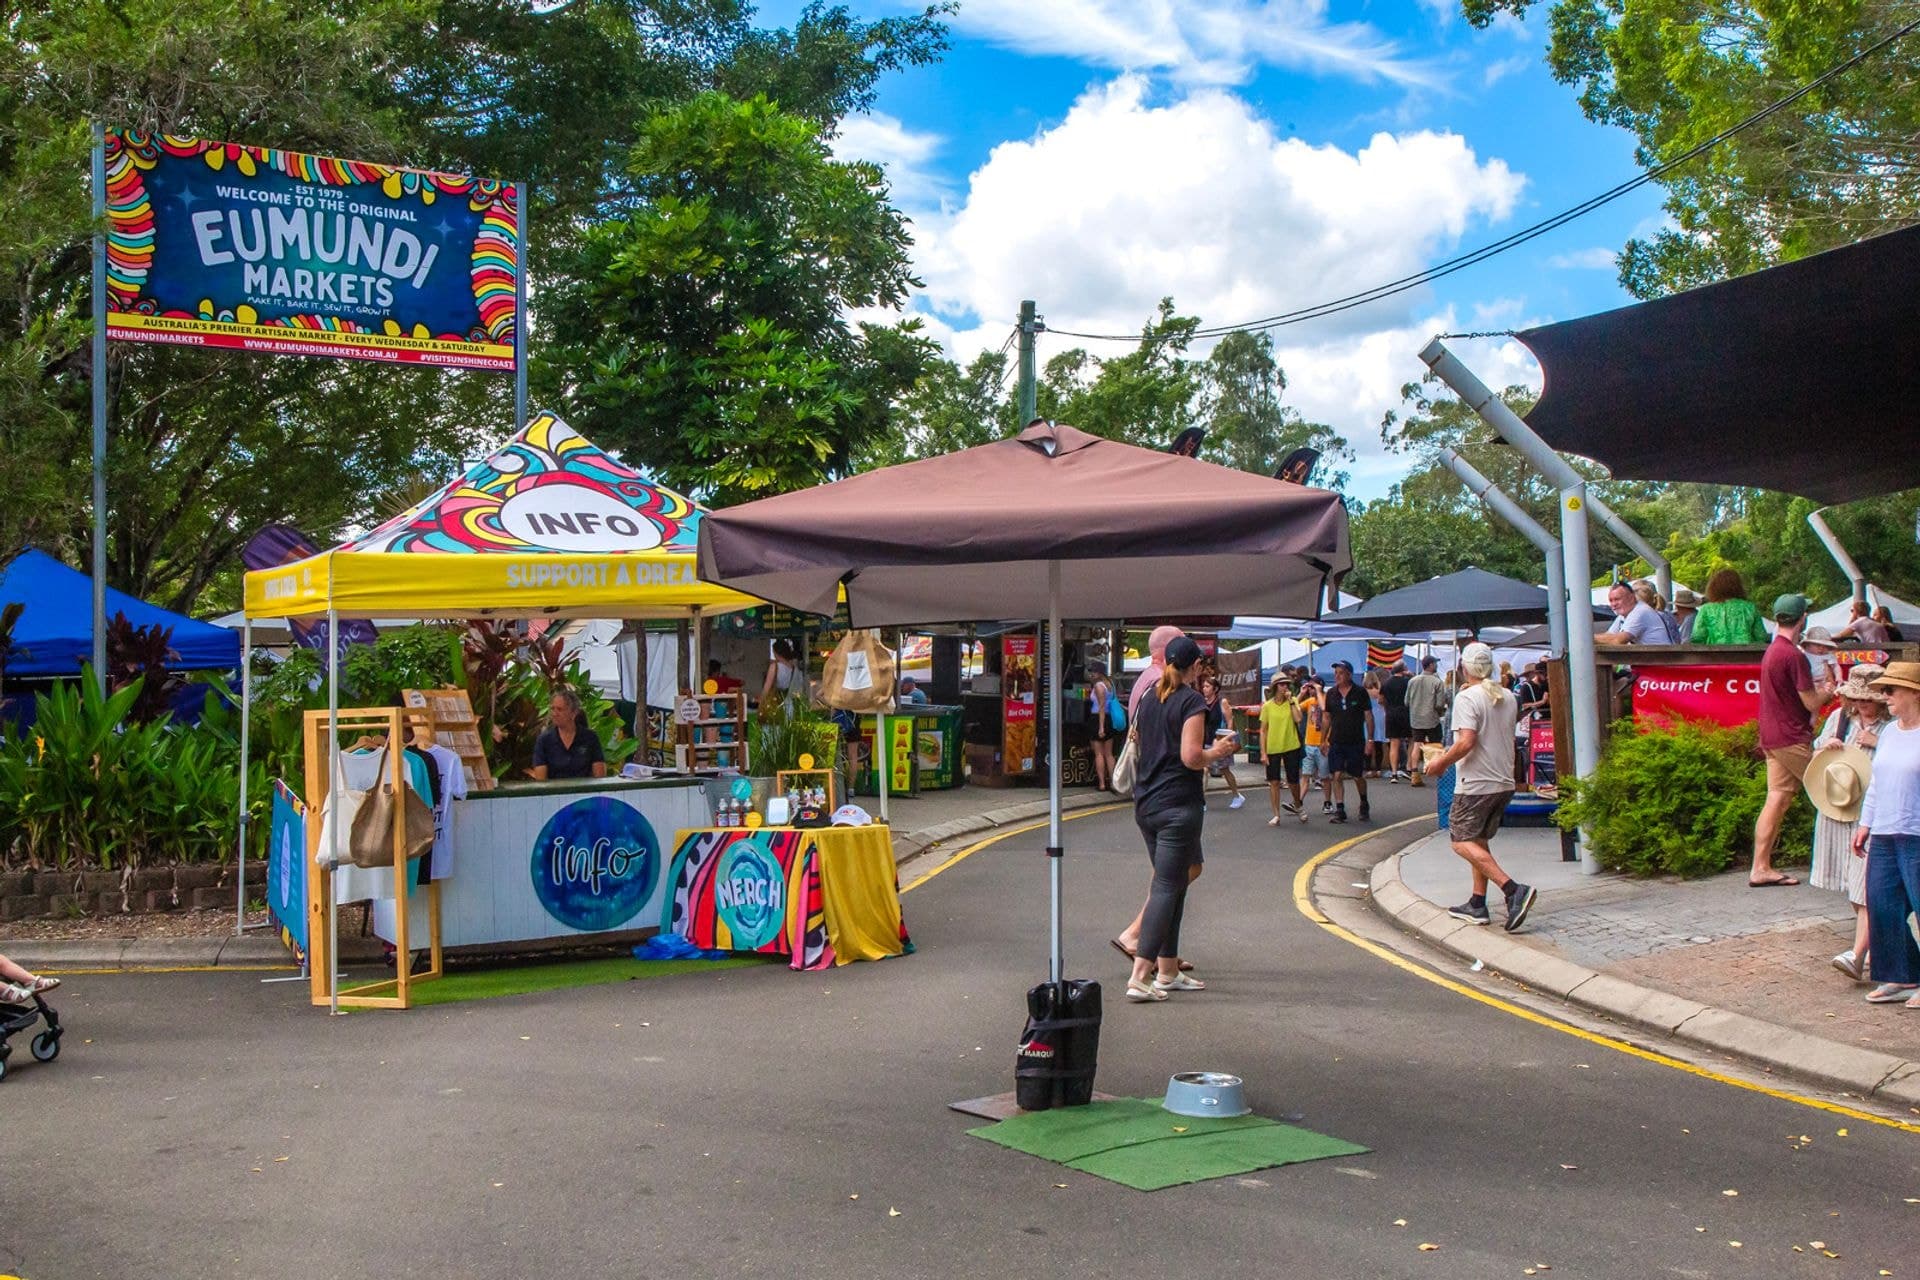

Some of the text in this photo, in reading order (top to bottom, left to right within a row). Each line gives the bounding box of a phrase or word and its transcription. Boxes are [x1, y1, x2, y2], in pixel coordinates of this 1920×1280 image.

[216, 185, 418, 222] WELCOME TO THE ORIGINAL
[295, 185, 315, 197] EST
[317, 188, 343, 200] 1979
[191, 207, 439, 289] EUMUNDI
[243, 262, 394, 308] MARKETS
[247, 296, 271, 306] MAKE
[287, 300, 309, 310] BAKE
[324, 303, 343, 312] SEW
[356, 306, 381, 316] GROW
[383, 308, 391, 317] IT
[106, 329, 205, 344] #EUMUNDIMARKETS
[143, 318, 208, 331] AUSTRALIA'S
[210, 322, 252, 335] PREMIER
[255, 326, 297, 338] ARTISAN
[298, 329, 337, 342] MARKET
[344, 335, 373, 345] EVERY
[375, 338, 430, 350] WEDNESDAY
[432, 342, 439, 350] &
[440, 343, 486, 354] SATURDAY
[243, 340, 399, 359] WWW.EUMUNDIMARKETS.COM.AU
[420, 353, 514, 369] #VISITSUNSHINECOAST
[524, 512, 640, 537] INFO
[506, 561, 698, 588] SUPPORT A DREA
[1636, 677, 1713, 698] gourmet
[552, 836, 647, 896] info
[717, 878, 782, 910] MERCH
